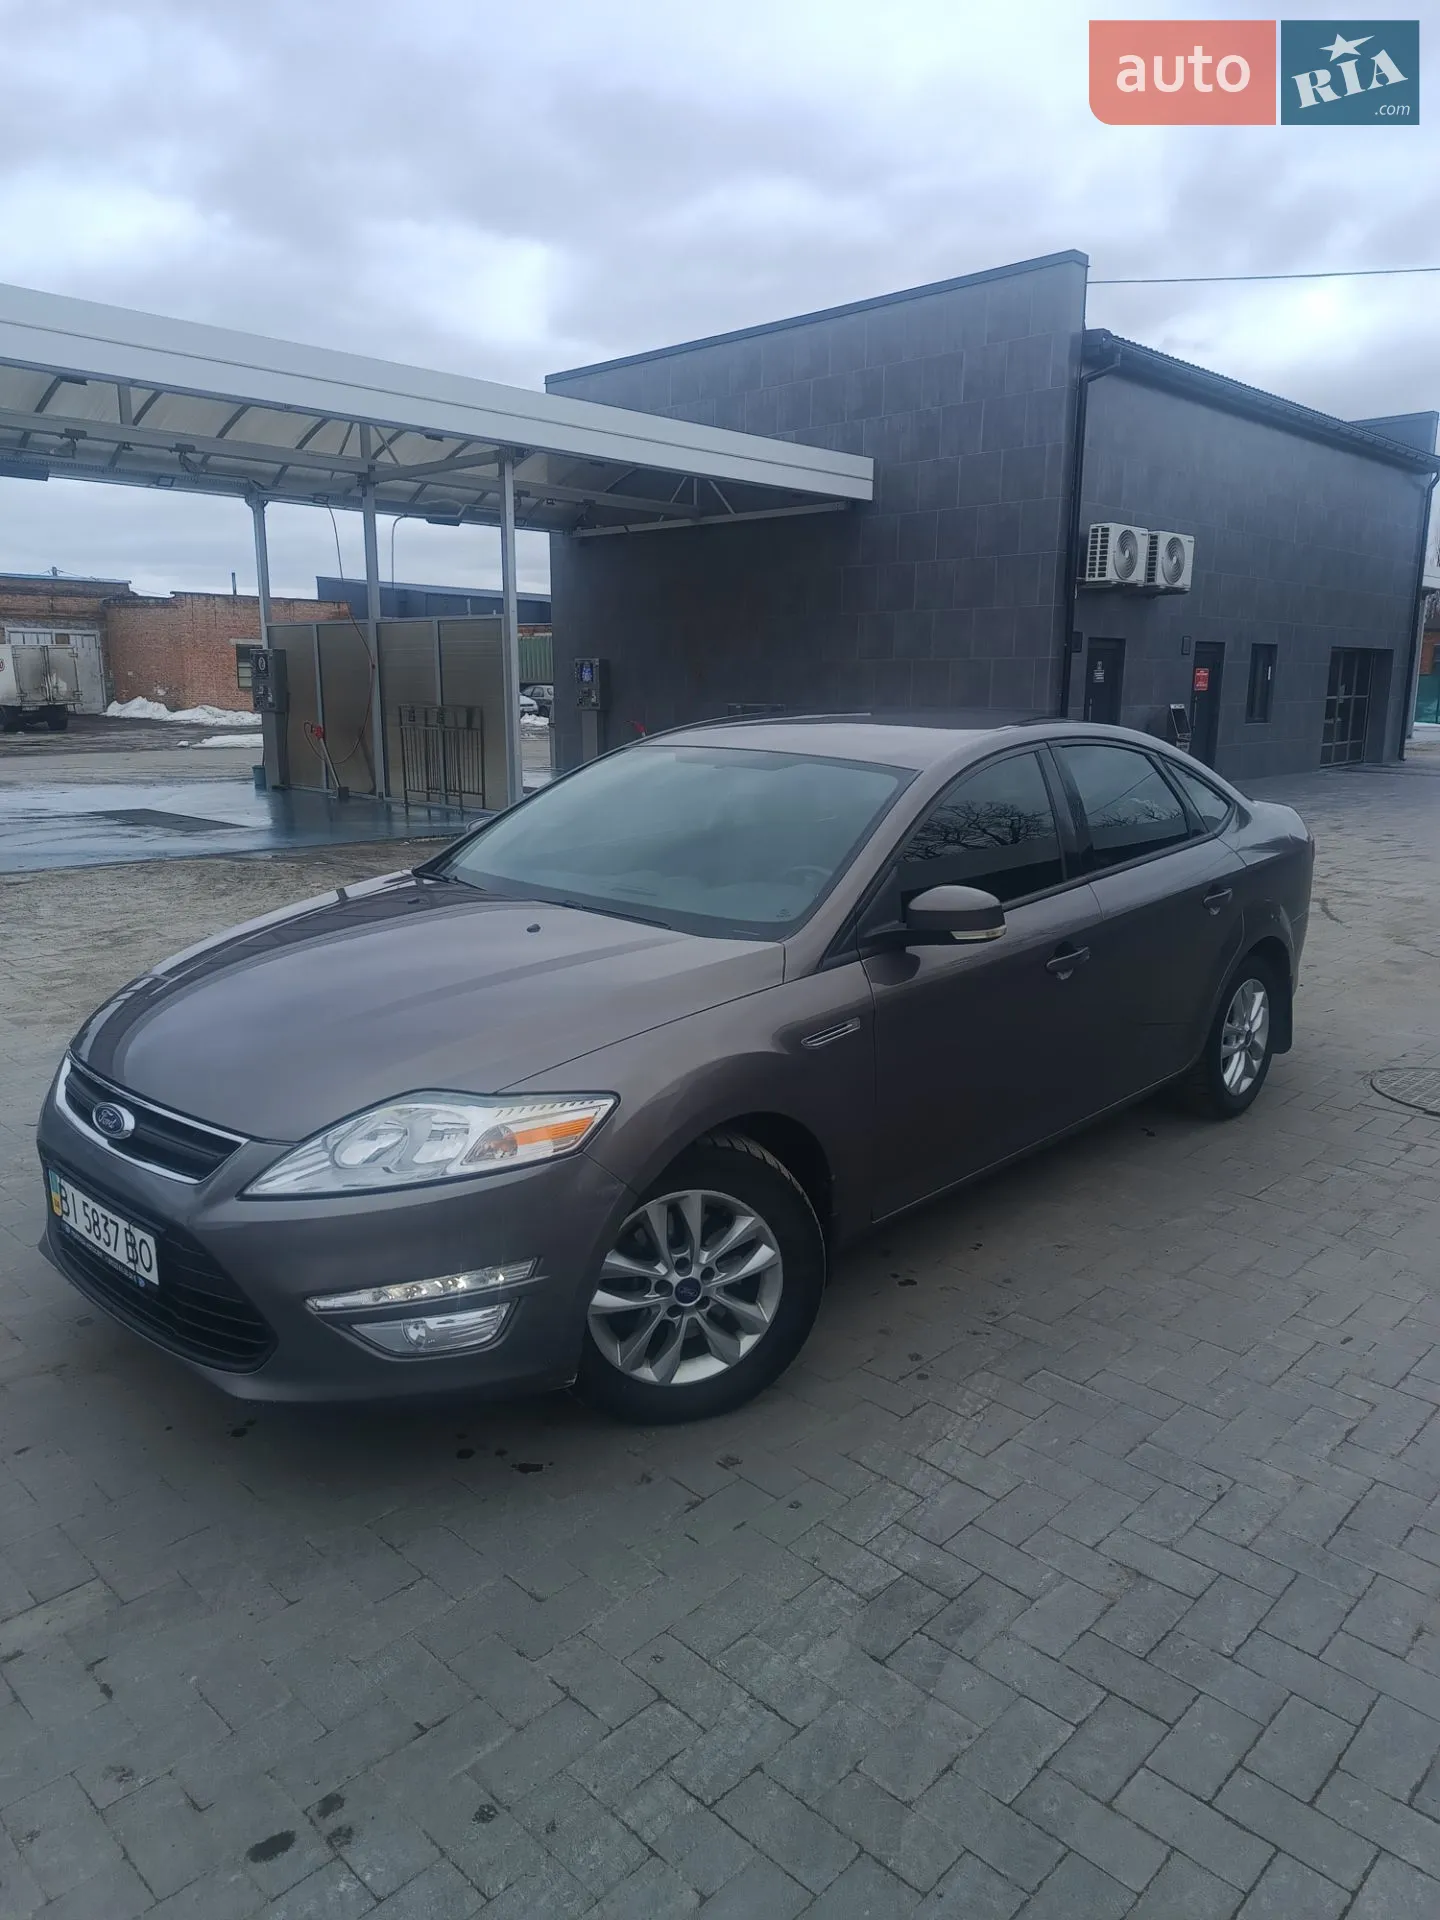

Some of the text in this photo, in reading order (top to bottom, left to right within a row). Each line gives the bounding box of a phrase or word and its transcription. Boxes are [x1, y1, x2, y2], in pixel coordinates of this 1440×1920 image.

[59, 1182, 78, 1225] BI
[82, 1200, 119, 1252] 5837
[124, 1227, 153, 1273] BO
